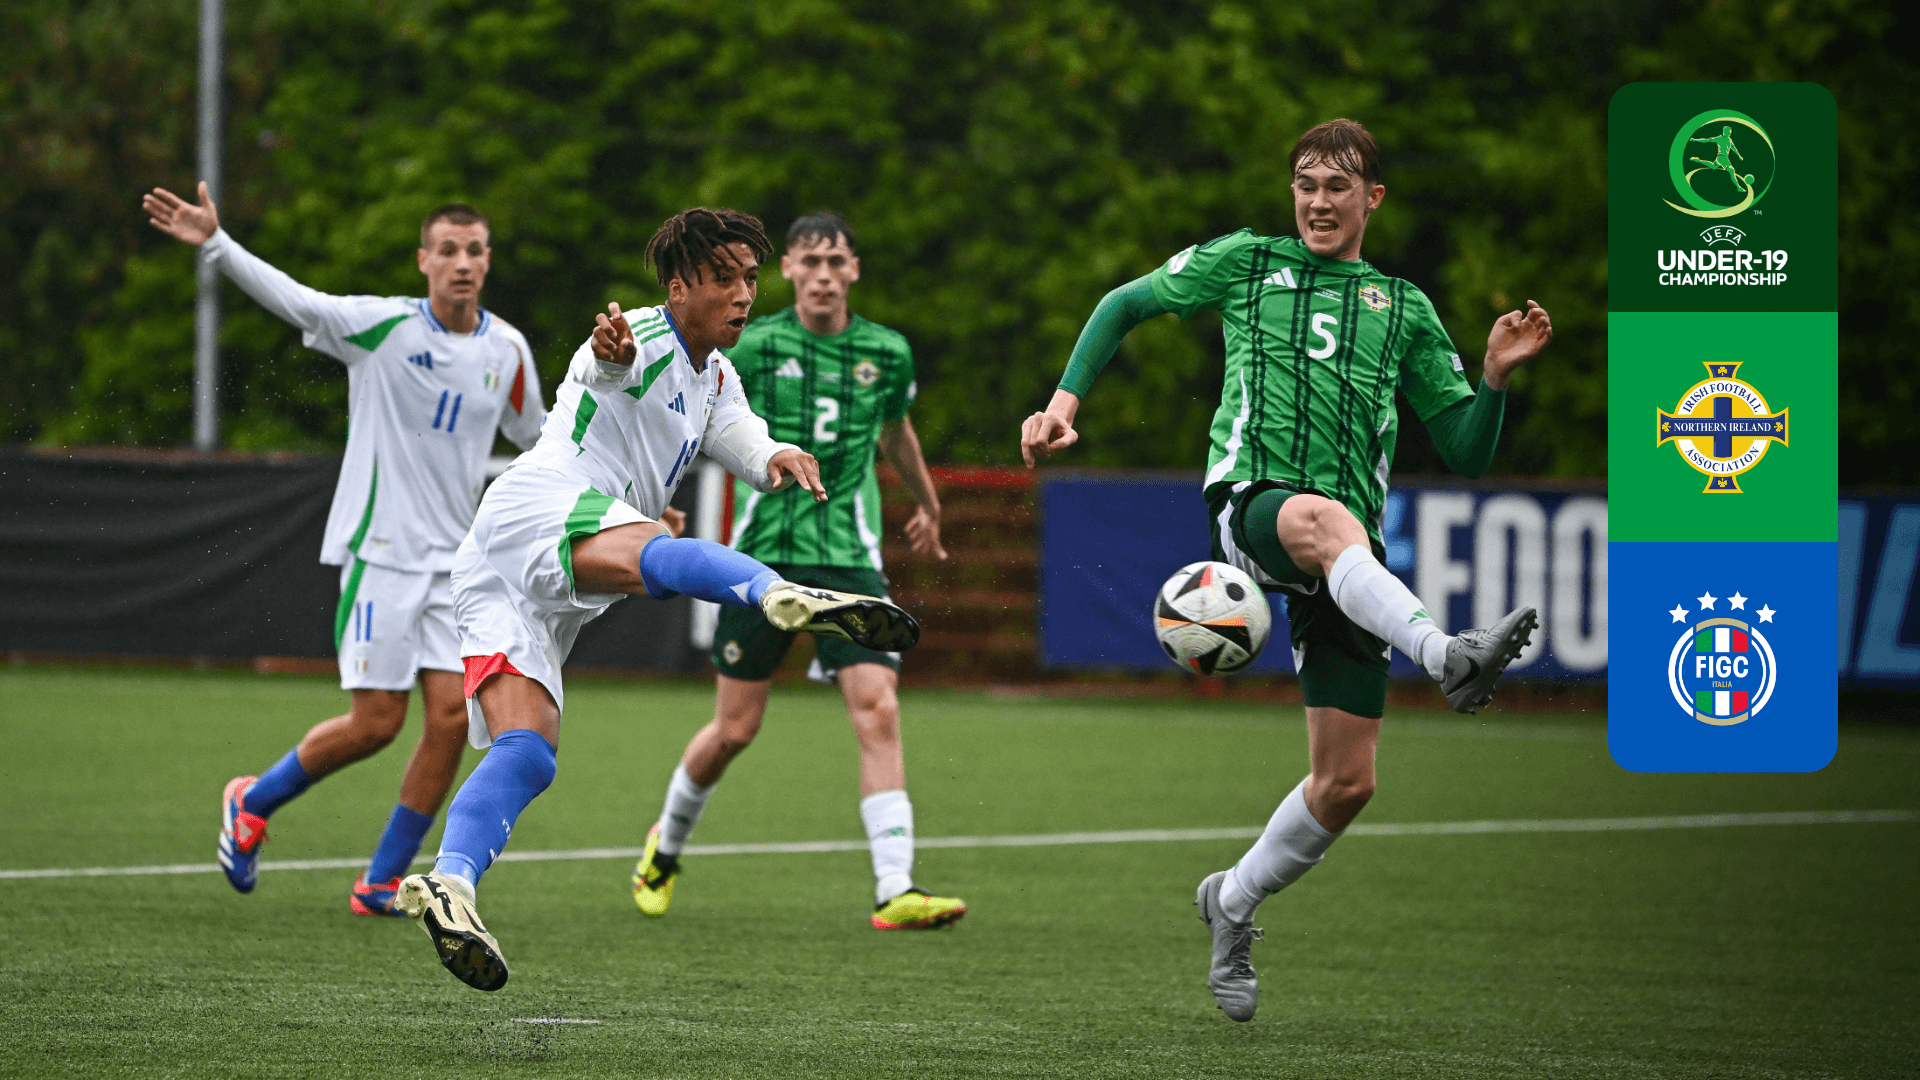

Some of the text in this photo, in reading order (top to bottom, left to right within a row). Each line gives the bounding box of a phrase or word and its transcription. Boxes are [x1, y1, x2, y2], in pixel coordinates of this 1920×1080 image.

[1307, 312, 1338, 360] 5
[432, 389, 463, 433] 11
[814, 397, 839, 442] 2
[355, 601, 373, 642] 11
